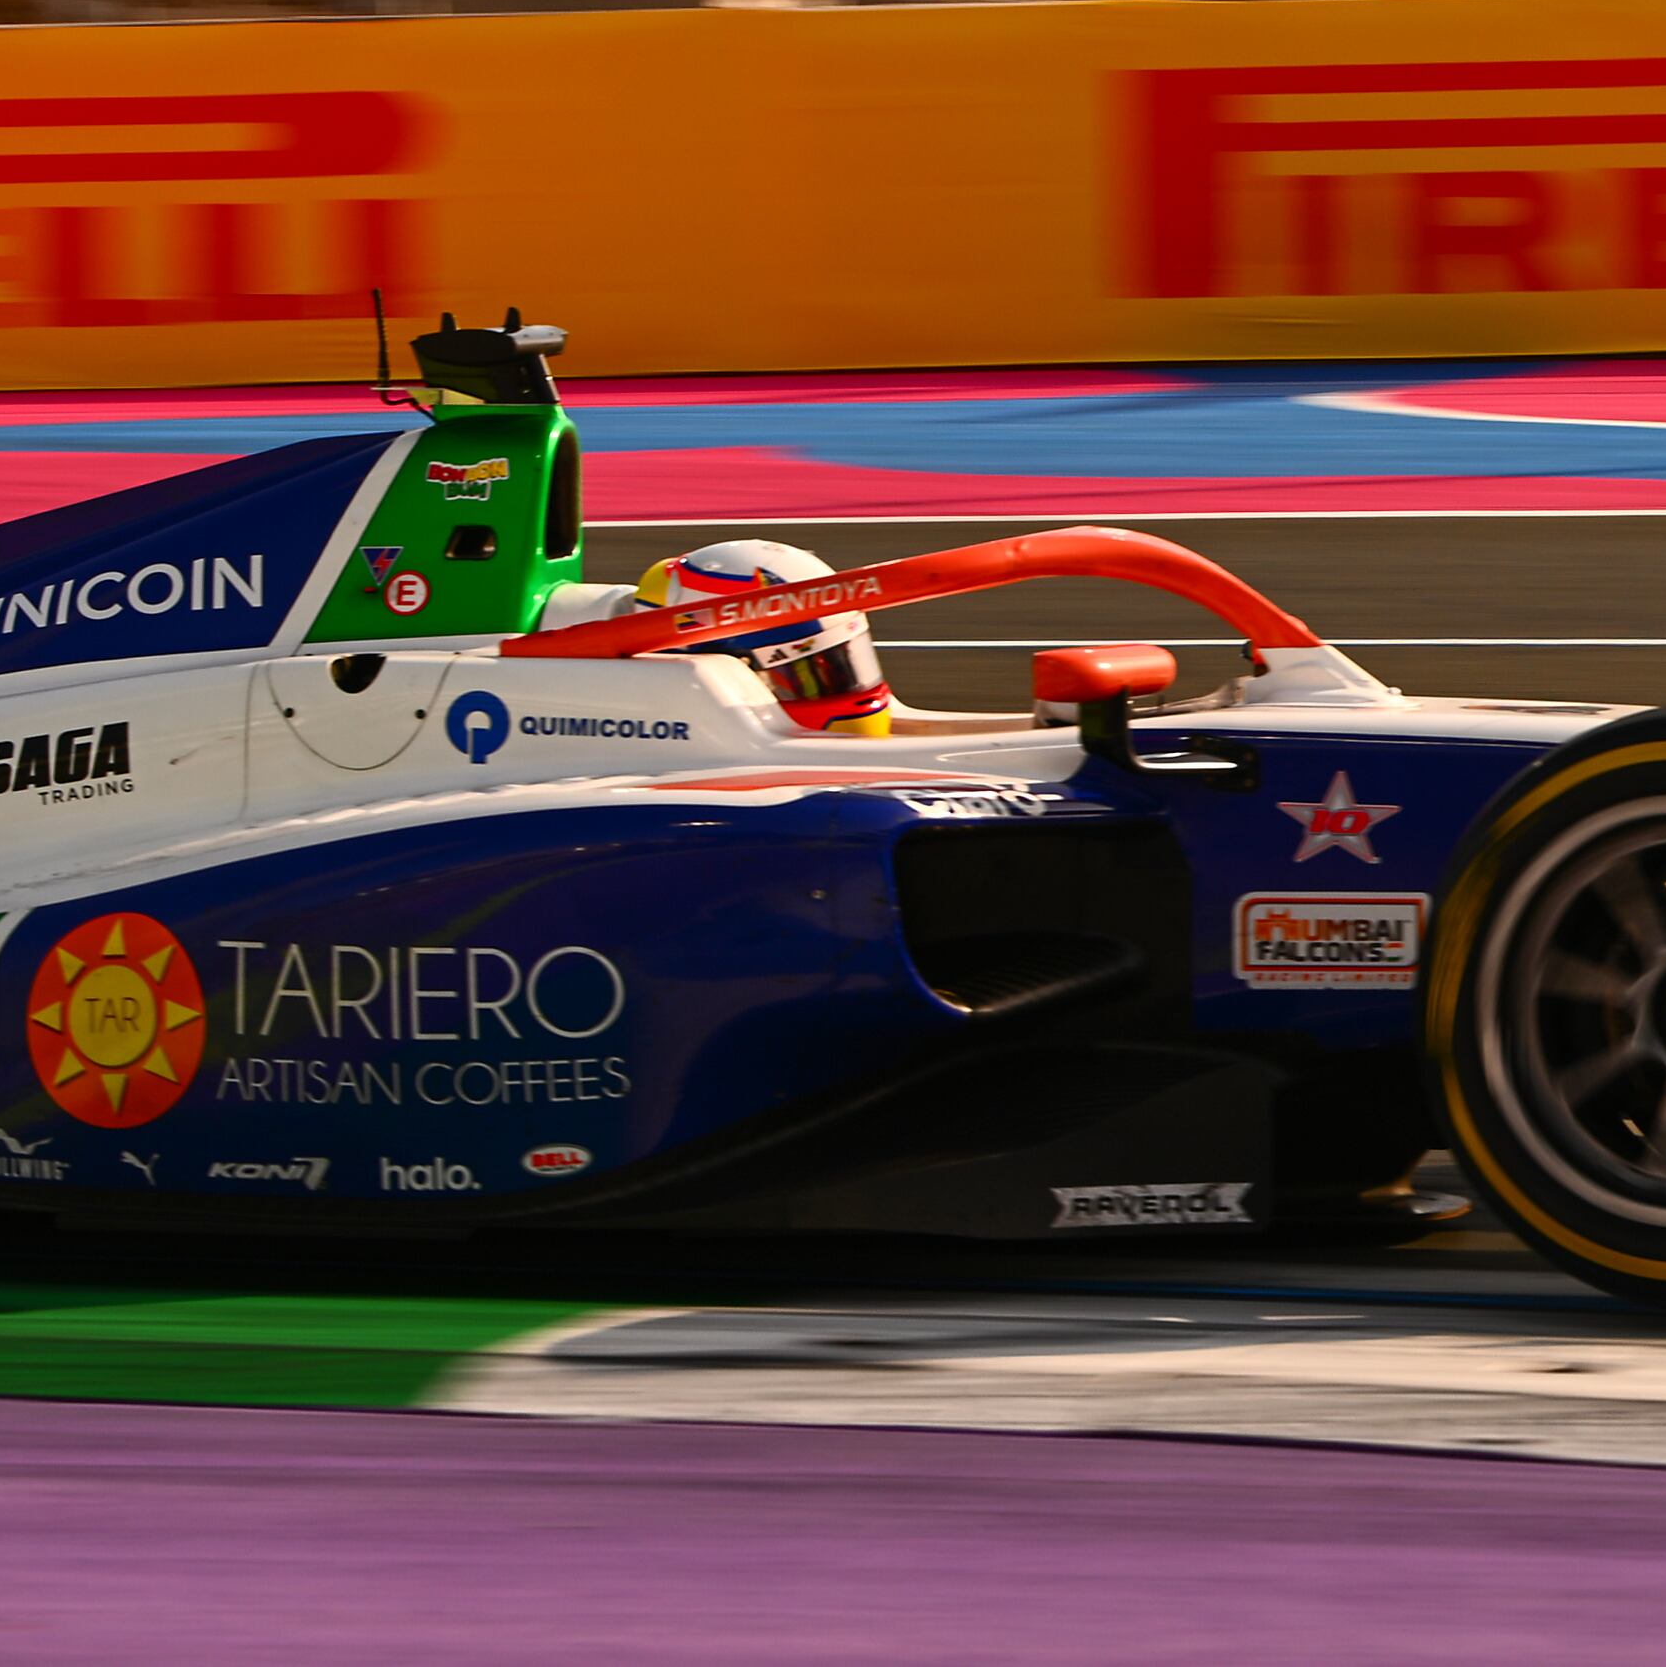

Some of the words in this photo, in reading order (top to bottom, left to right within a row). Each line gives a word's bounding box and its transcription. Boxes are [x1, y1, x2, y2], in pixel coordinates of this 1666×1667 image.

[397, 580, 417, 606] E
[519, 714, 691, 742] QUIMICOLOR
[38, 779, 134, 806] TRADING
[1309, 809, 1369, 834] 10
[1254, 910, 1406, 942] MUMBAI
[1255, 941, 1387, 962] FALCONS
[218, 940, 625, 1039] TARIERO
[84, 997, 141, 1034] TAR
[217, 1057, 401, 1105] ARTISAN
[415, 1056, 631, 1105] COFFEES
[531, 1151, 585, 1168] BELL
[380, 1156, 484, 1192] halo.
[1073, 1192, 1233, 1218] RAVENOL
